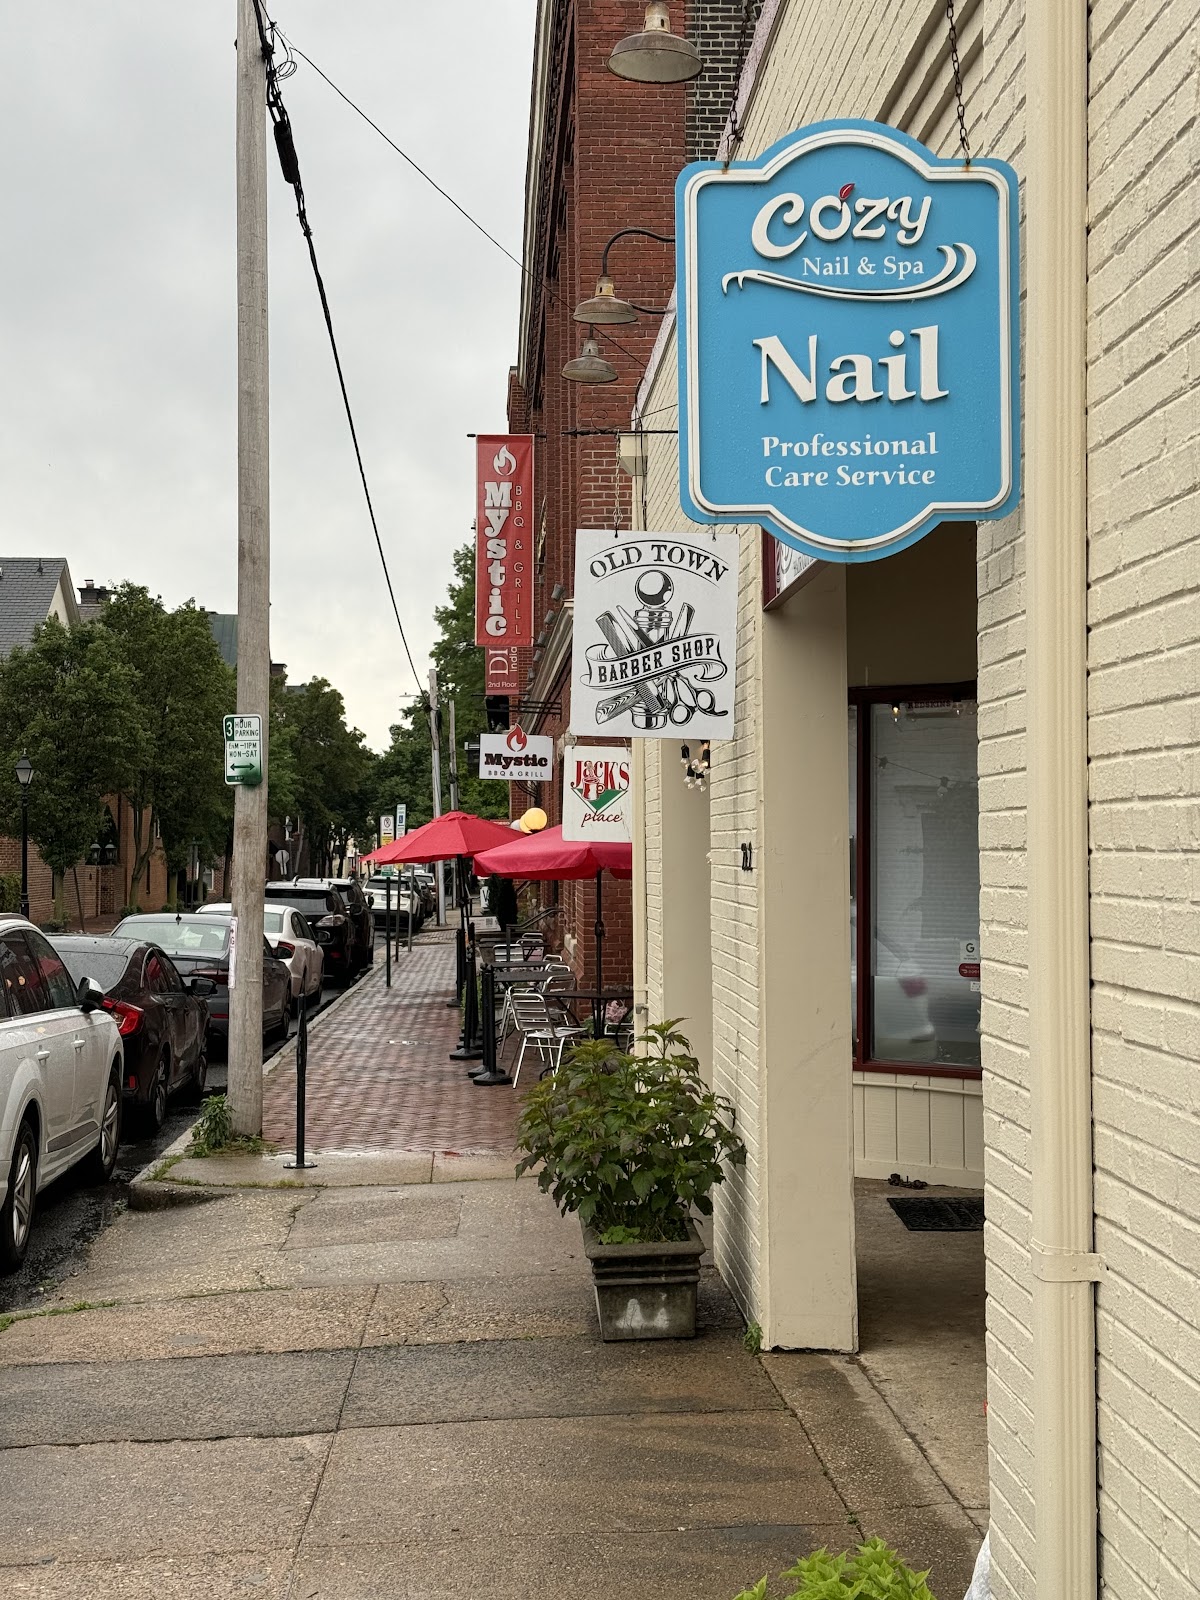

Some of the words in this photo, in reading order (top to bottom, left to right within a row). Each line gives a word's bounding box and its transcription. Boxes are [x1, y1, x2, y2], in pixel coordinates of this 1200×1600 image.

[802, 256, 850, 276] Nail
[857, 257, 876, 276] &
[883, 256, 924, 281] Spa
[752, 324, 950, 405] Nail
[761, 432, 939, 457] Professional
[765, 466, 829, 488] Care
[836, 465, 936, 486] Service
[513, 485, 524, 527] BBQ
[484, 481, 512, 637] Mystic
[589, 546, 642, 578] OLD
[651, 544, 729, 582] TOWN
[513, 562, 524, 635] GRILL
[598, 653, 663, 684] BARBER
[671, 637, 715, 663] SHOP
[226, 721, 233, 737] 3
[234, 720, 252, 729] HOUR
[234, 729, 259, 737] PARKING
[484, 753, 548, 770] Mystic
[581, 810, 623, 828] place
